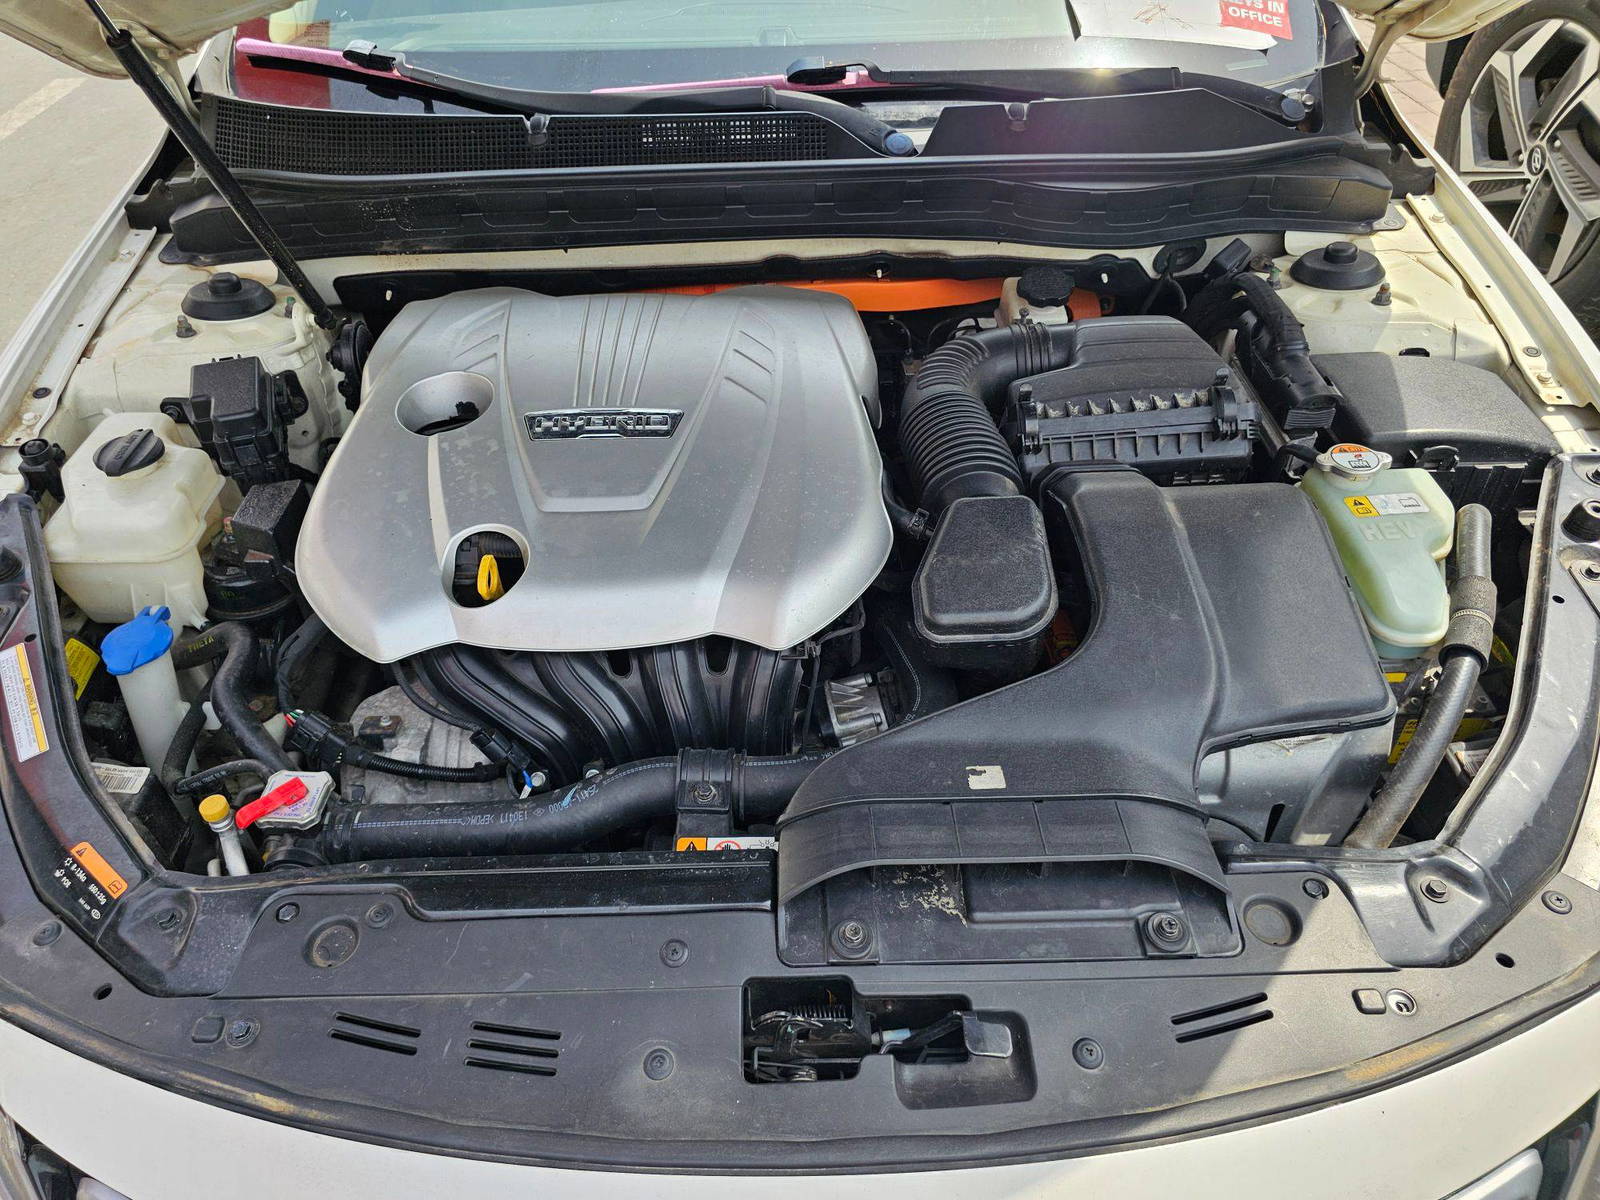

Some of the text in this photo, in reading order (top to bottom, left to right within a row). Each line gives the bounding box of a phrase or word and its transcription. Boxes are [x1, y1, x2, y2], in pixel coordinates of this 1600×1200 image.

[1266, 0, 1285, 14] IN
[1228, 6, 1283, 27] OFFICE
[534, 415, 671, 433] HYBRID
